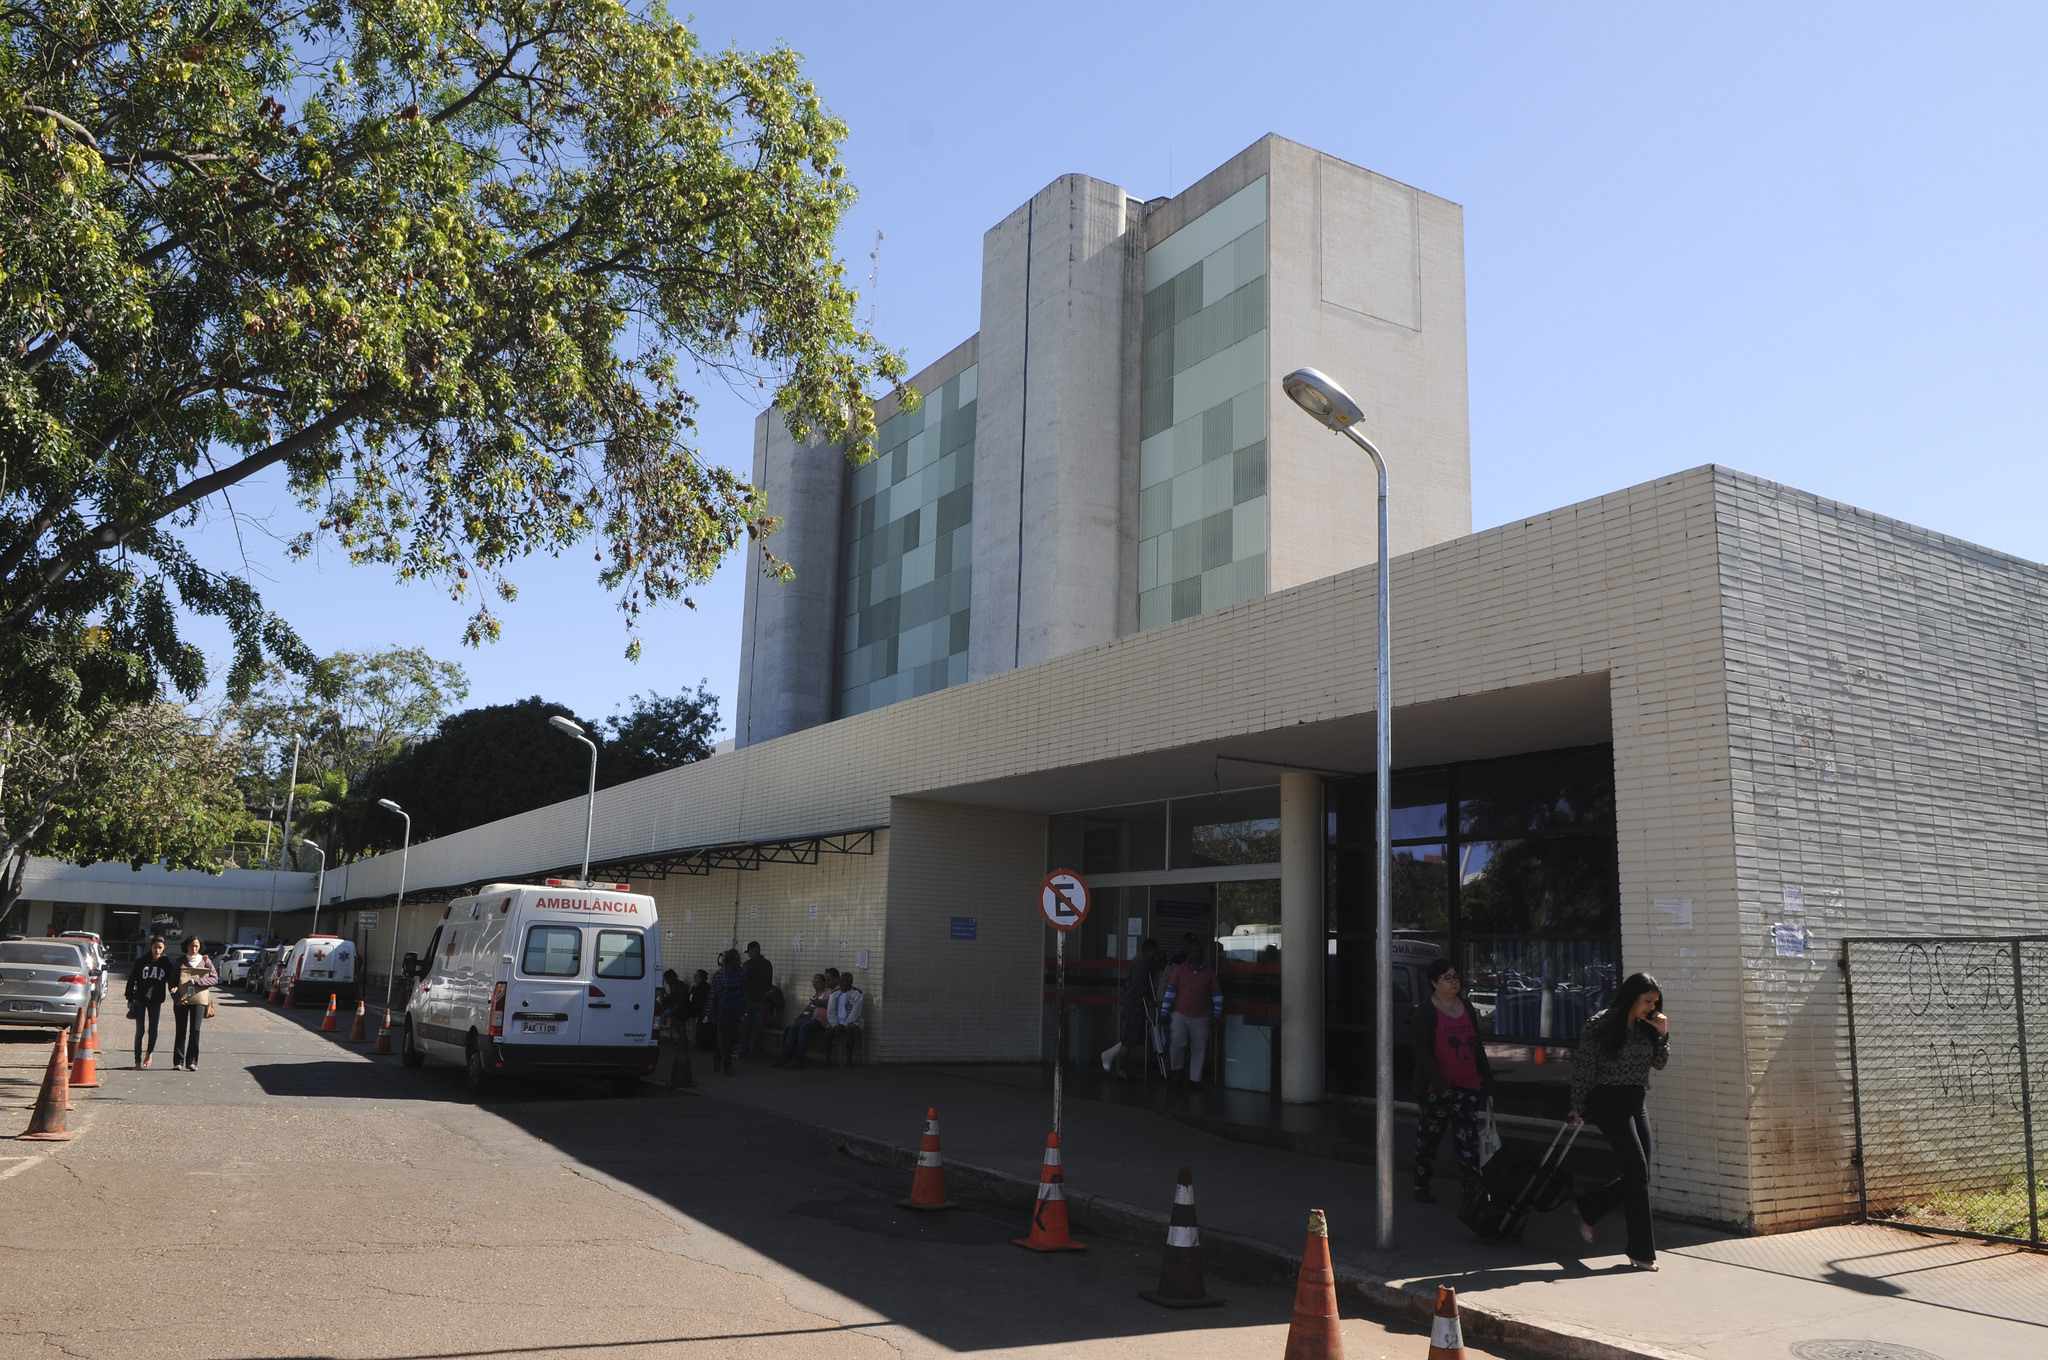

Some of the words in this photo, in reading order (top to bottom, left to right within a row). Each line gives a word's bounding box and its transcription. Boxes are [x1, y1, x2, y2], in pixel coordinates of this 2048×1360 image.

[535, 897, 638, 914] AMBULÂNCIA
[1054, 883, 1075, 917] E
[142, 966, 166, 981] GAP
